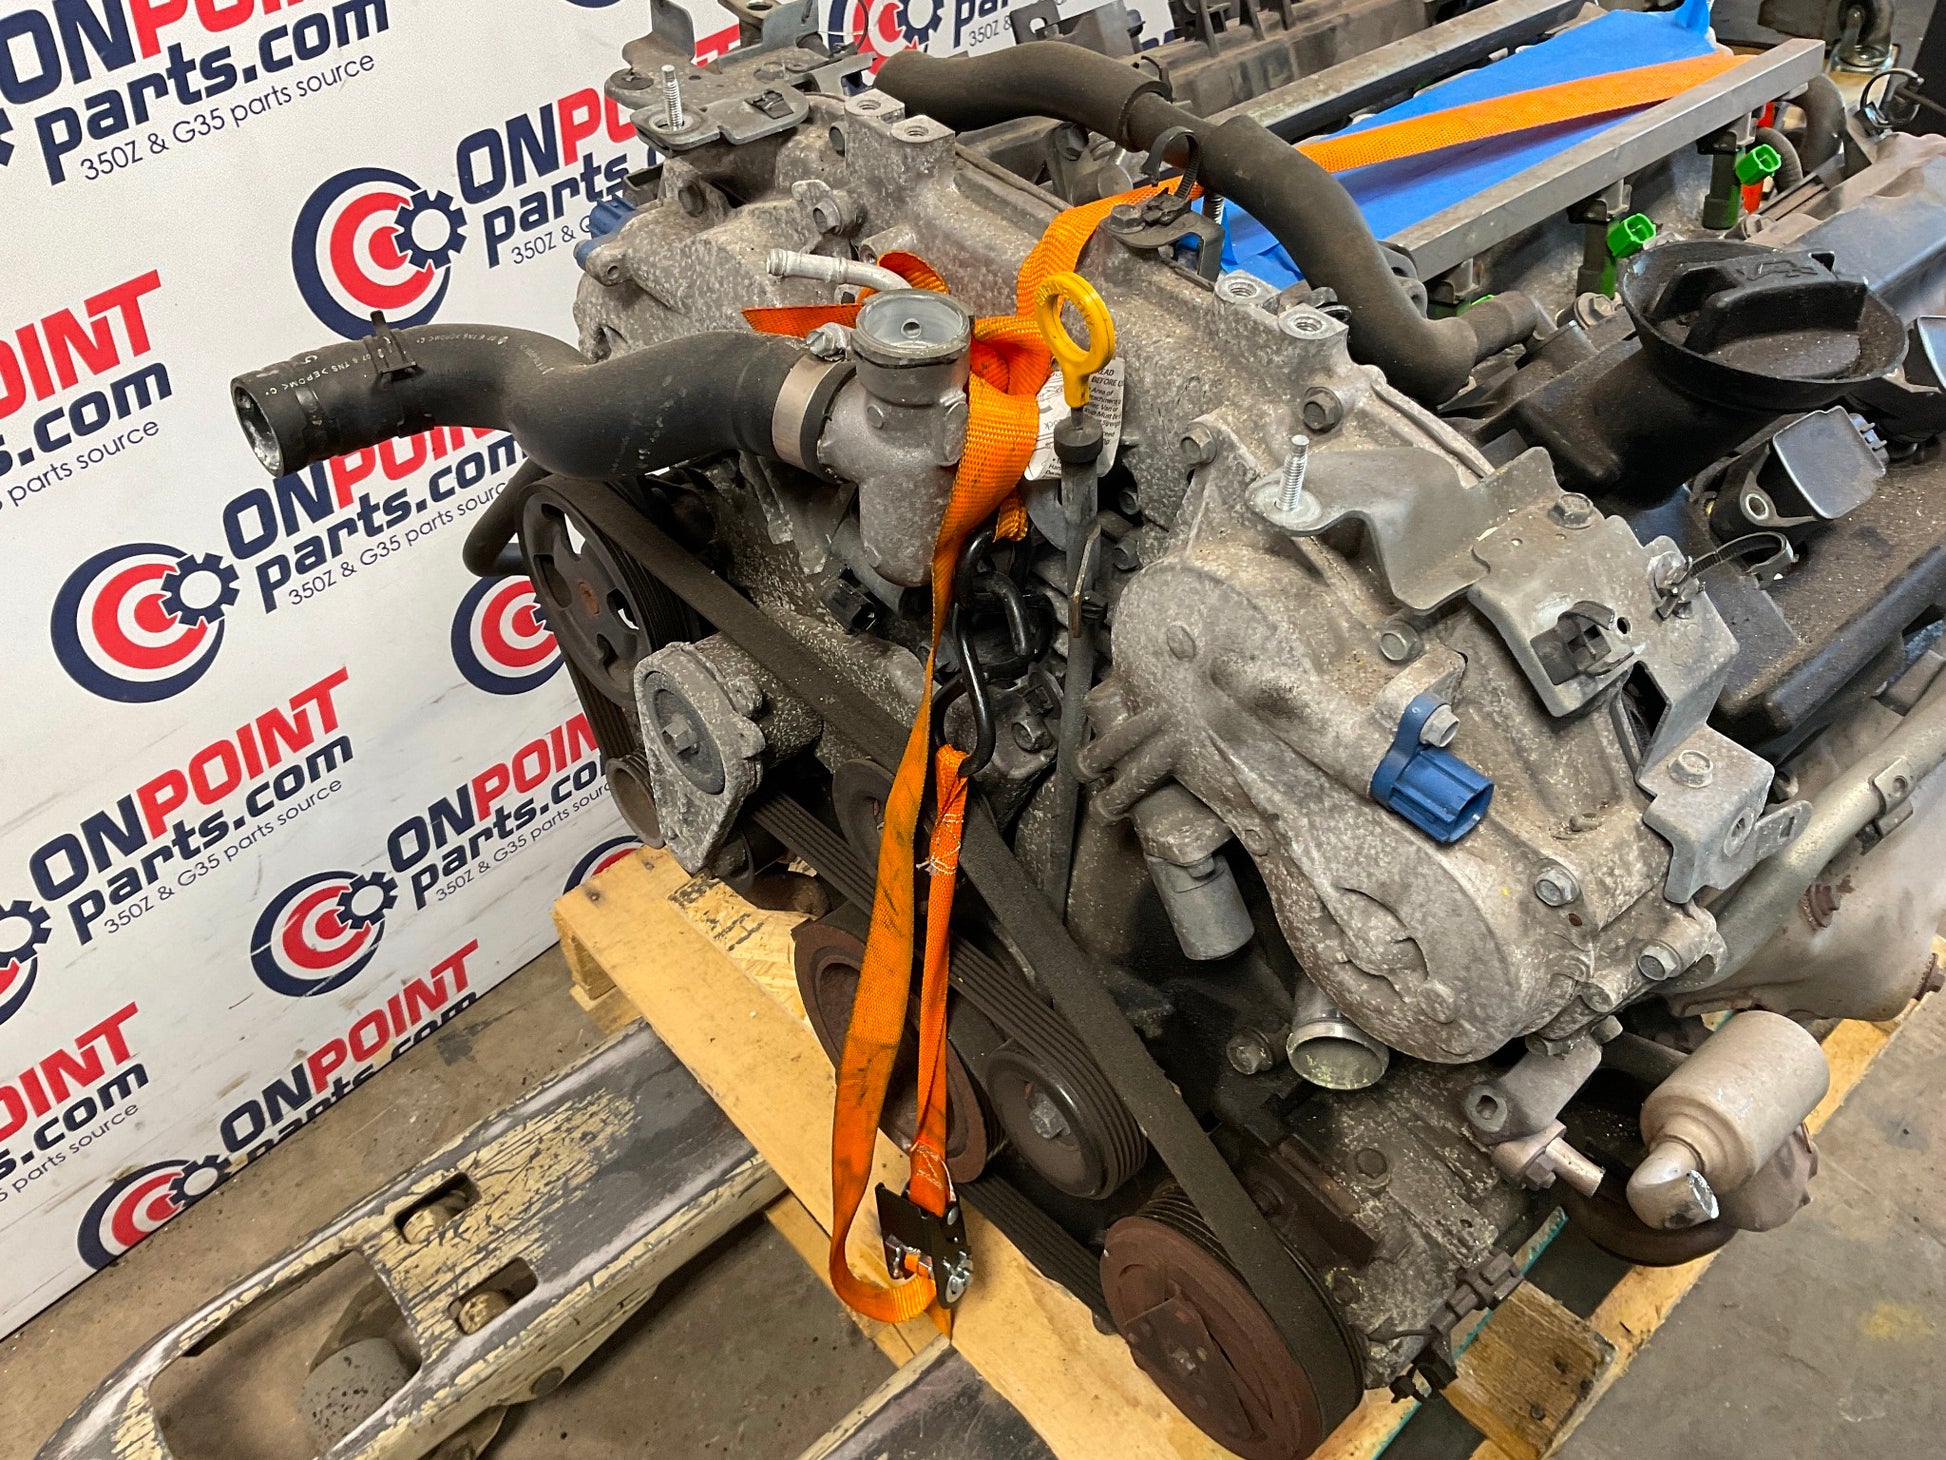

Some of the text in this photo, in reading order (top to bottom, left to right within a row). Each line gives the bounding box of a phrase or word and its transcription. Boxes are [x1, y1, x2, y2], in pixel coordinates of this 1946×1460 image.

[35, 0, 389, 186] parts.com
[968, 20, 999, 47] 350Z
[80, 54, 375, 181] 350Z & G35 parts source
[483, 151, 632, 269] parts
[510, 225, 577, 265] 350Z &
[7, 421, 159, 507] parts source
[288, 482, 507, 605] 350Z & G35 parts sourc
[29, 665, 349, 901] ONPOINT
[67, 735, 353, 946] parts.com
[387, 712, 598, 873] ONPOIN
[411, 754, 607, 911] parts.co
[436, 782, 610, 902] 350Z & G35 parts sourc
[104, 778, 342, 934] 350Z & G35 parts source
[220, 938, 479, 1152] ONPOINT
[12, 1103, 139, 1193] parts source
